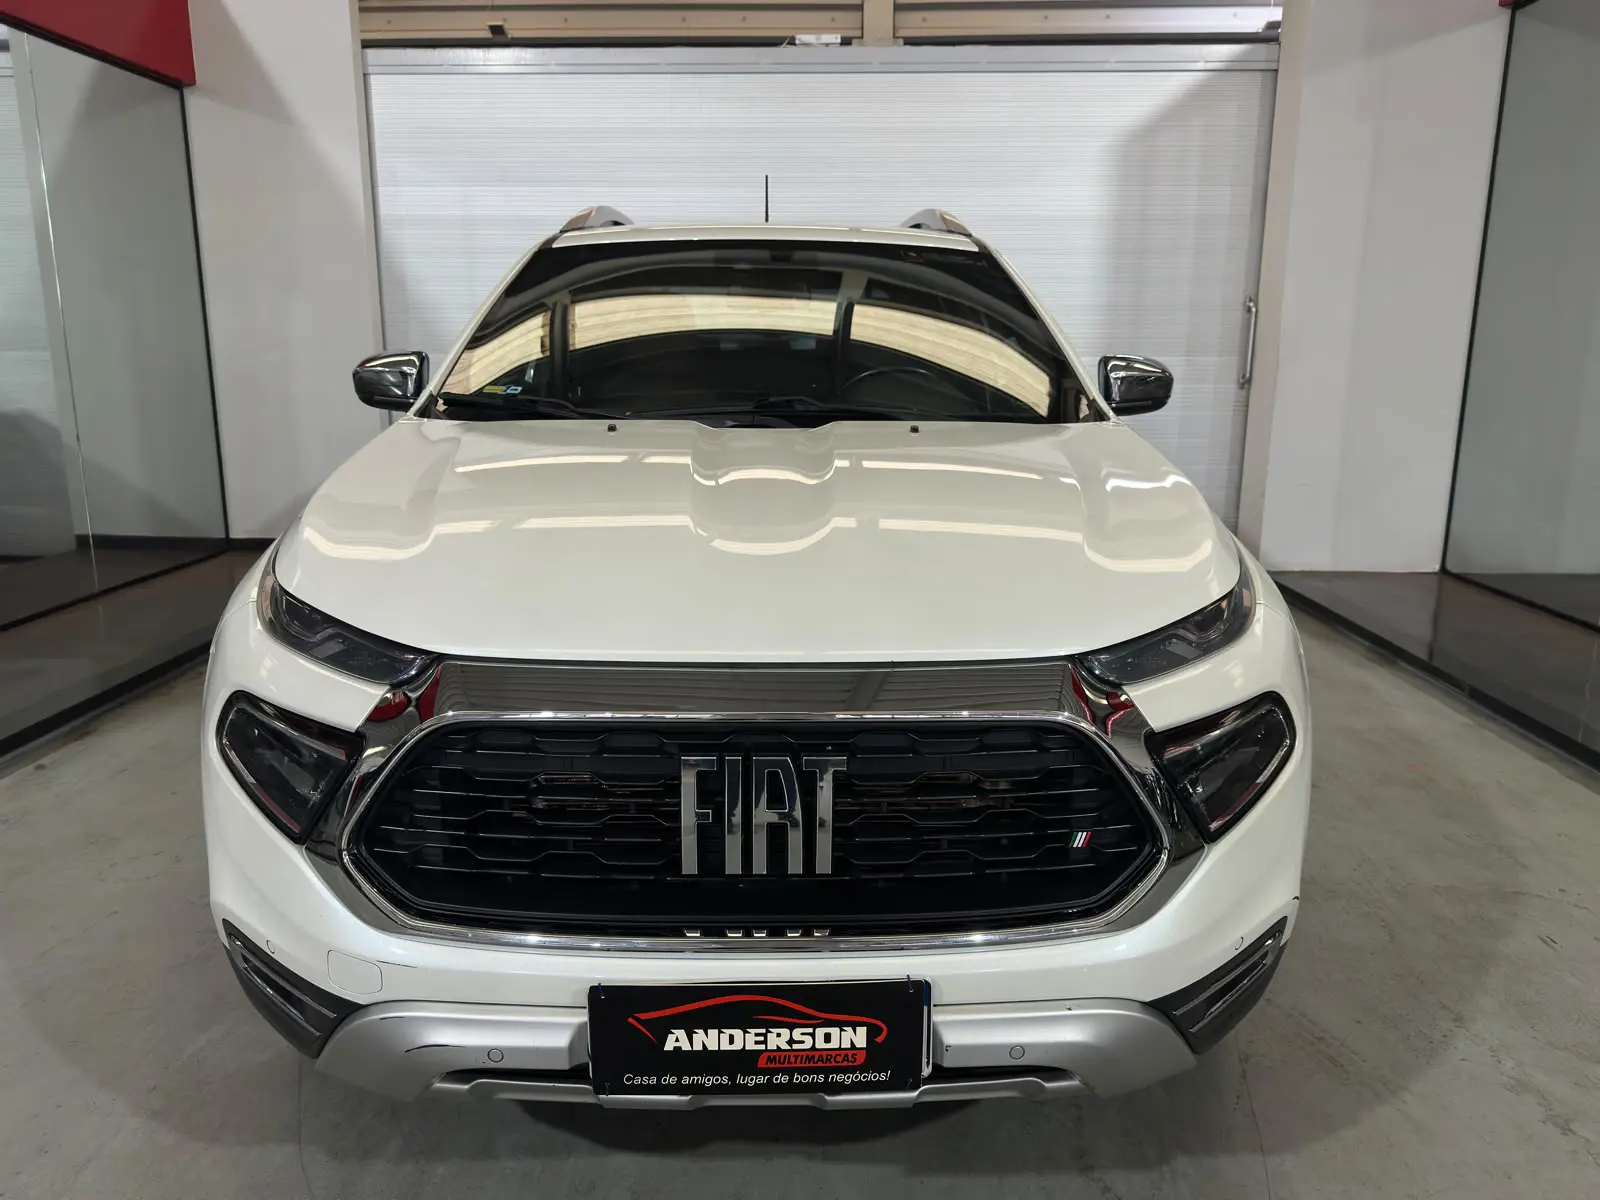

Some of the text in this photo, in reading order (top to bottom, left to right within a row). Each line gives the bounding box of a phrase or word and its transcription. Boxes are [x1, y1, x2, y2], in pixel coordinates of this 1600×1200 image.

[681, 757, 847, 874] FIAT
[663, 1026, 867, 1051] ANDERSON
[765, 1053, 858, 1066] MULTIMARCAS
[623, 1070, 891, 1087] Casa de amigos, lugar de bons negócios!
